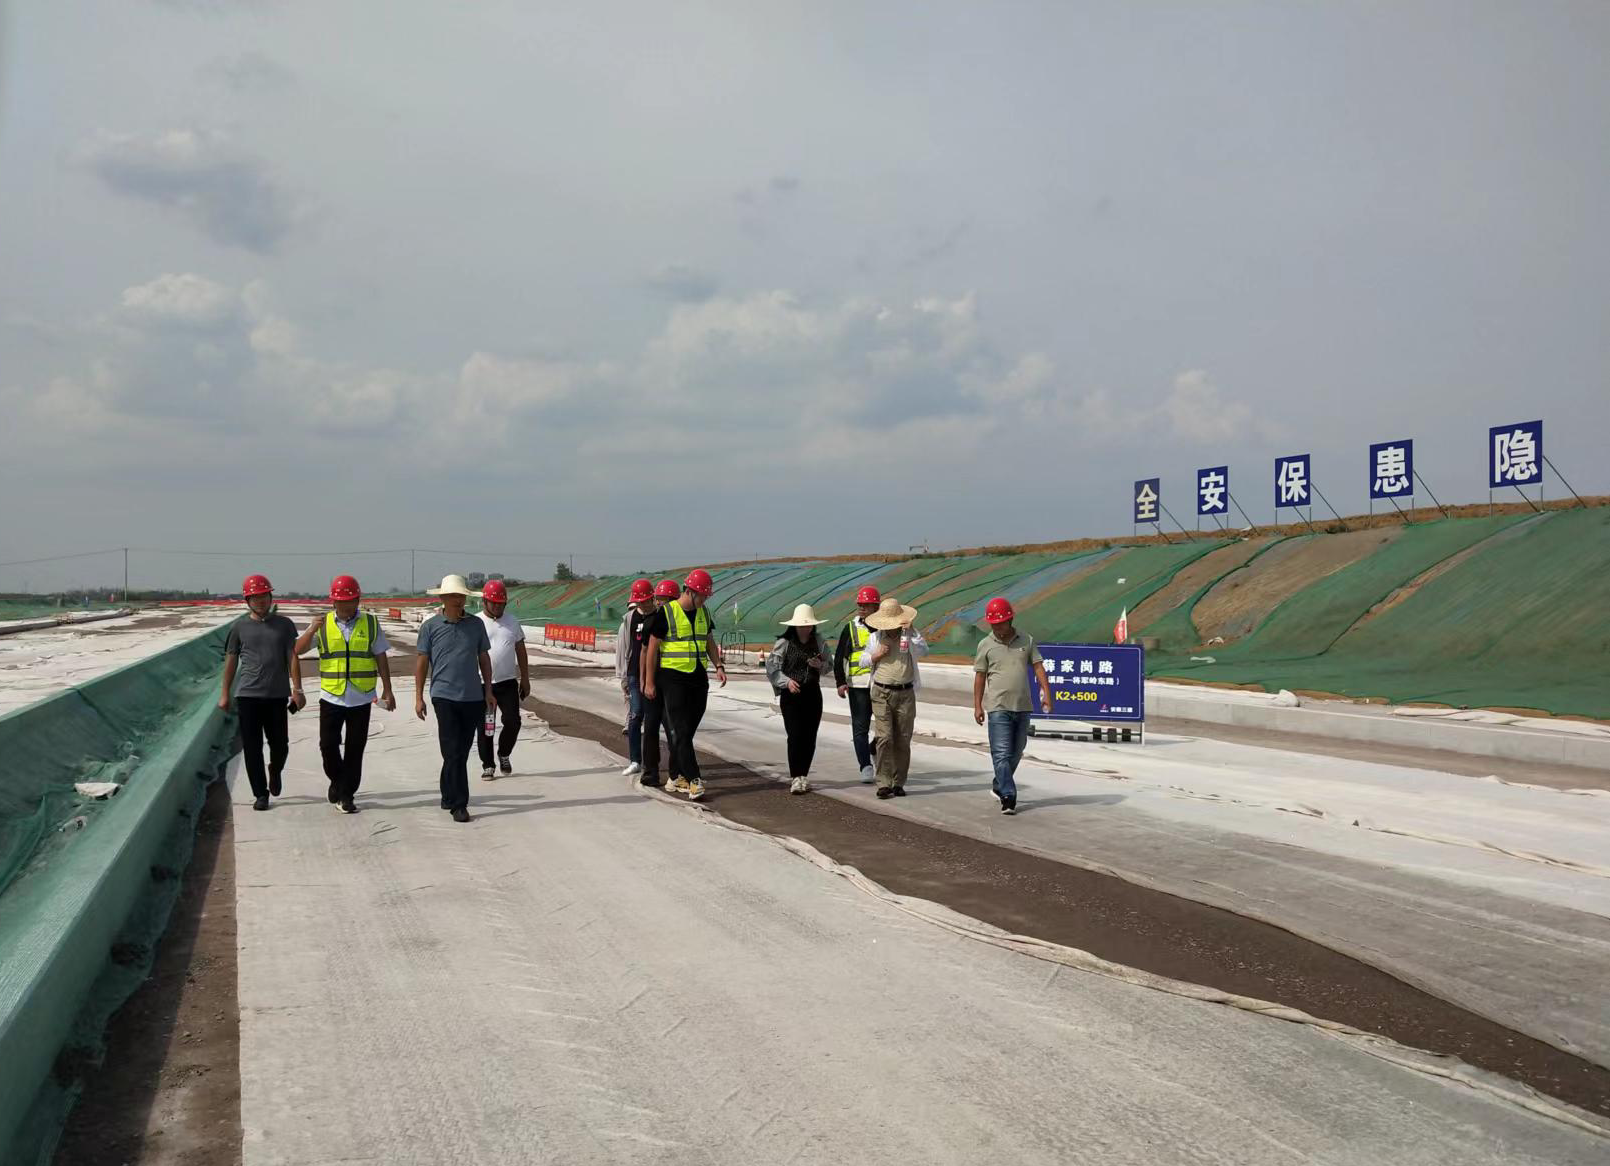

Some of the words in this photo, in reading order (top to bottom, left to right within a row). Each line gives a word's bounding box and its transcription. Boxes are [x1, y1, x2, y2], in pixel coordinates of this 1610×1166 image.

[1136, 484, 1158, 519] 全
[1200, 471, 1225, 512] 安
[1277, 461, 1308, 503] 保
[1373, 446, 1410, 493] 患
[1494, 429, 1538, 484] 隐
[1055, 691, 1097, 701] K2+500
